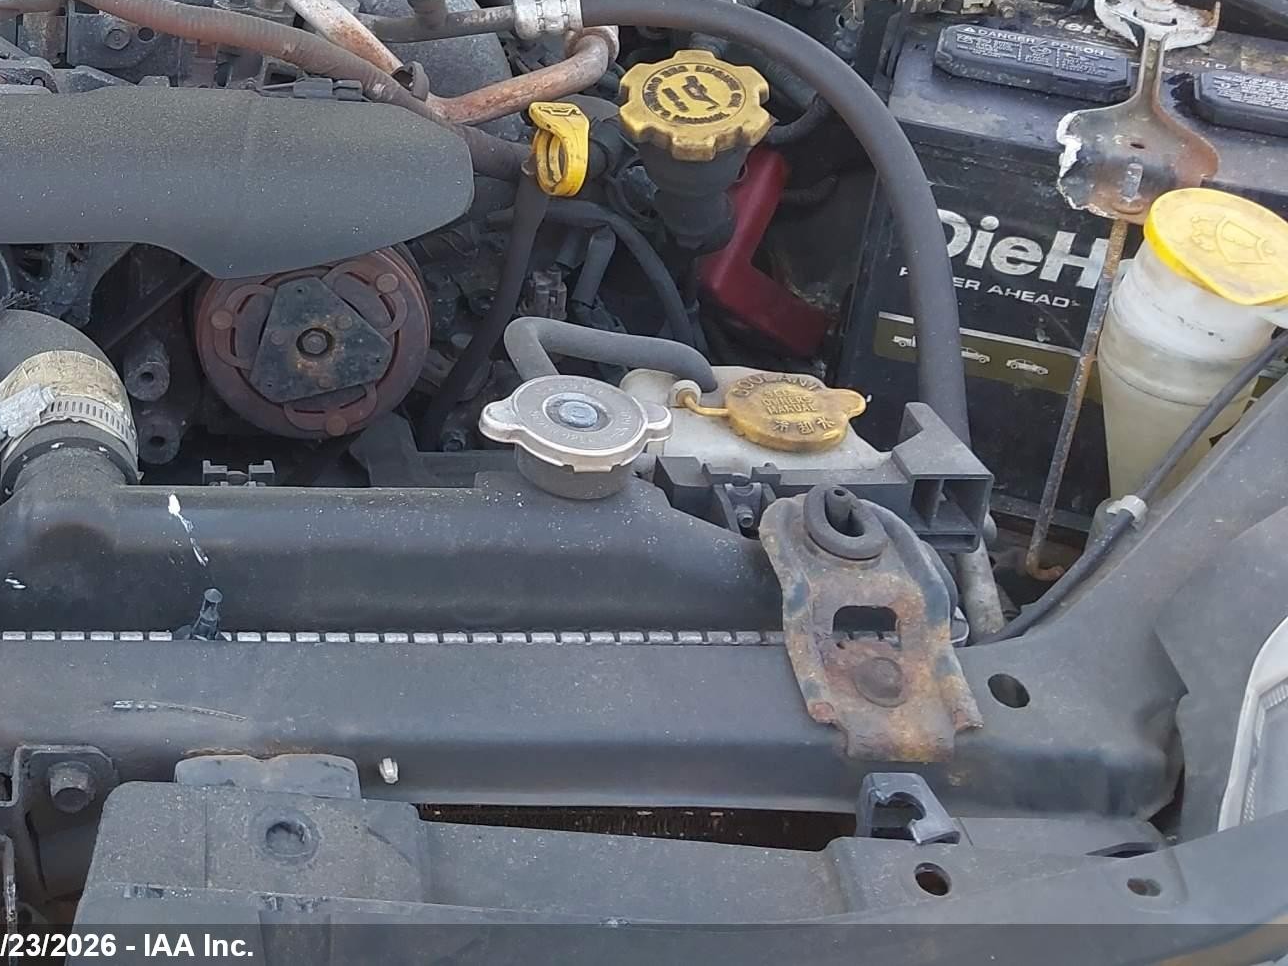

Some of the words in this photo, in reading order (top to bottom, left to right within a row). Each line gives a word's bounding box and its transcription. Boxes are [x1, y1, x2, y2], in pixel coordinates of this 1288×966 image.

[977, 28, 1035, 44] DANGER
[1051, 40, 1104, 56] POISON
[987, 284, 1070, 309] AHEAD
[732, 373, 822, 397] COOLANT
[766, 403, 818, 414] MANUAL
